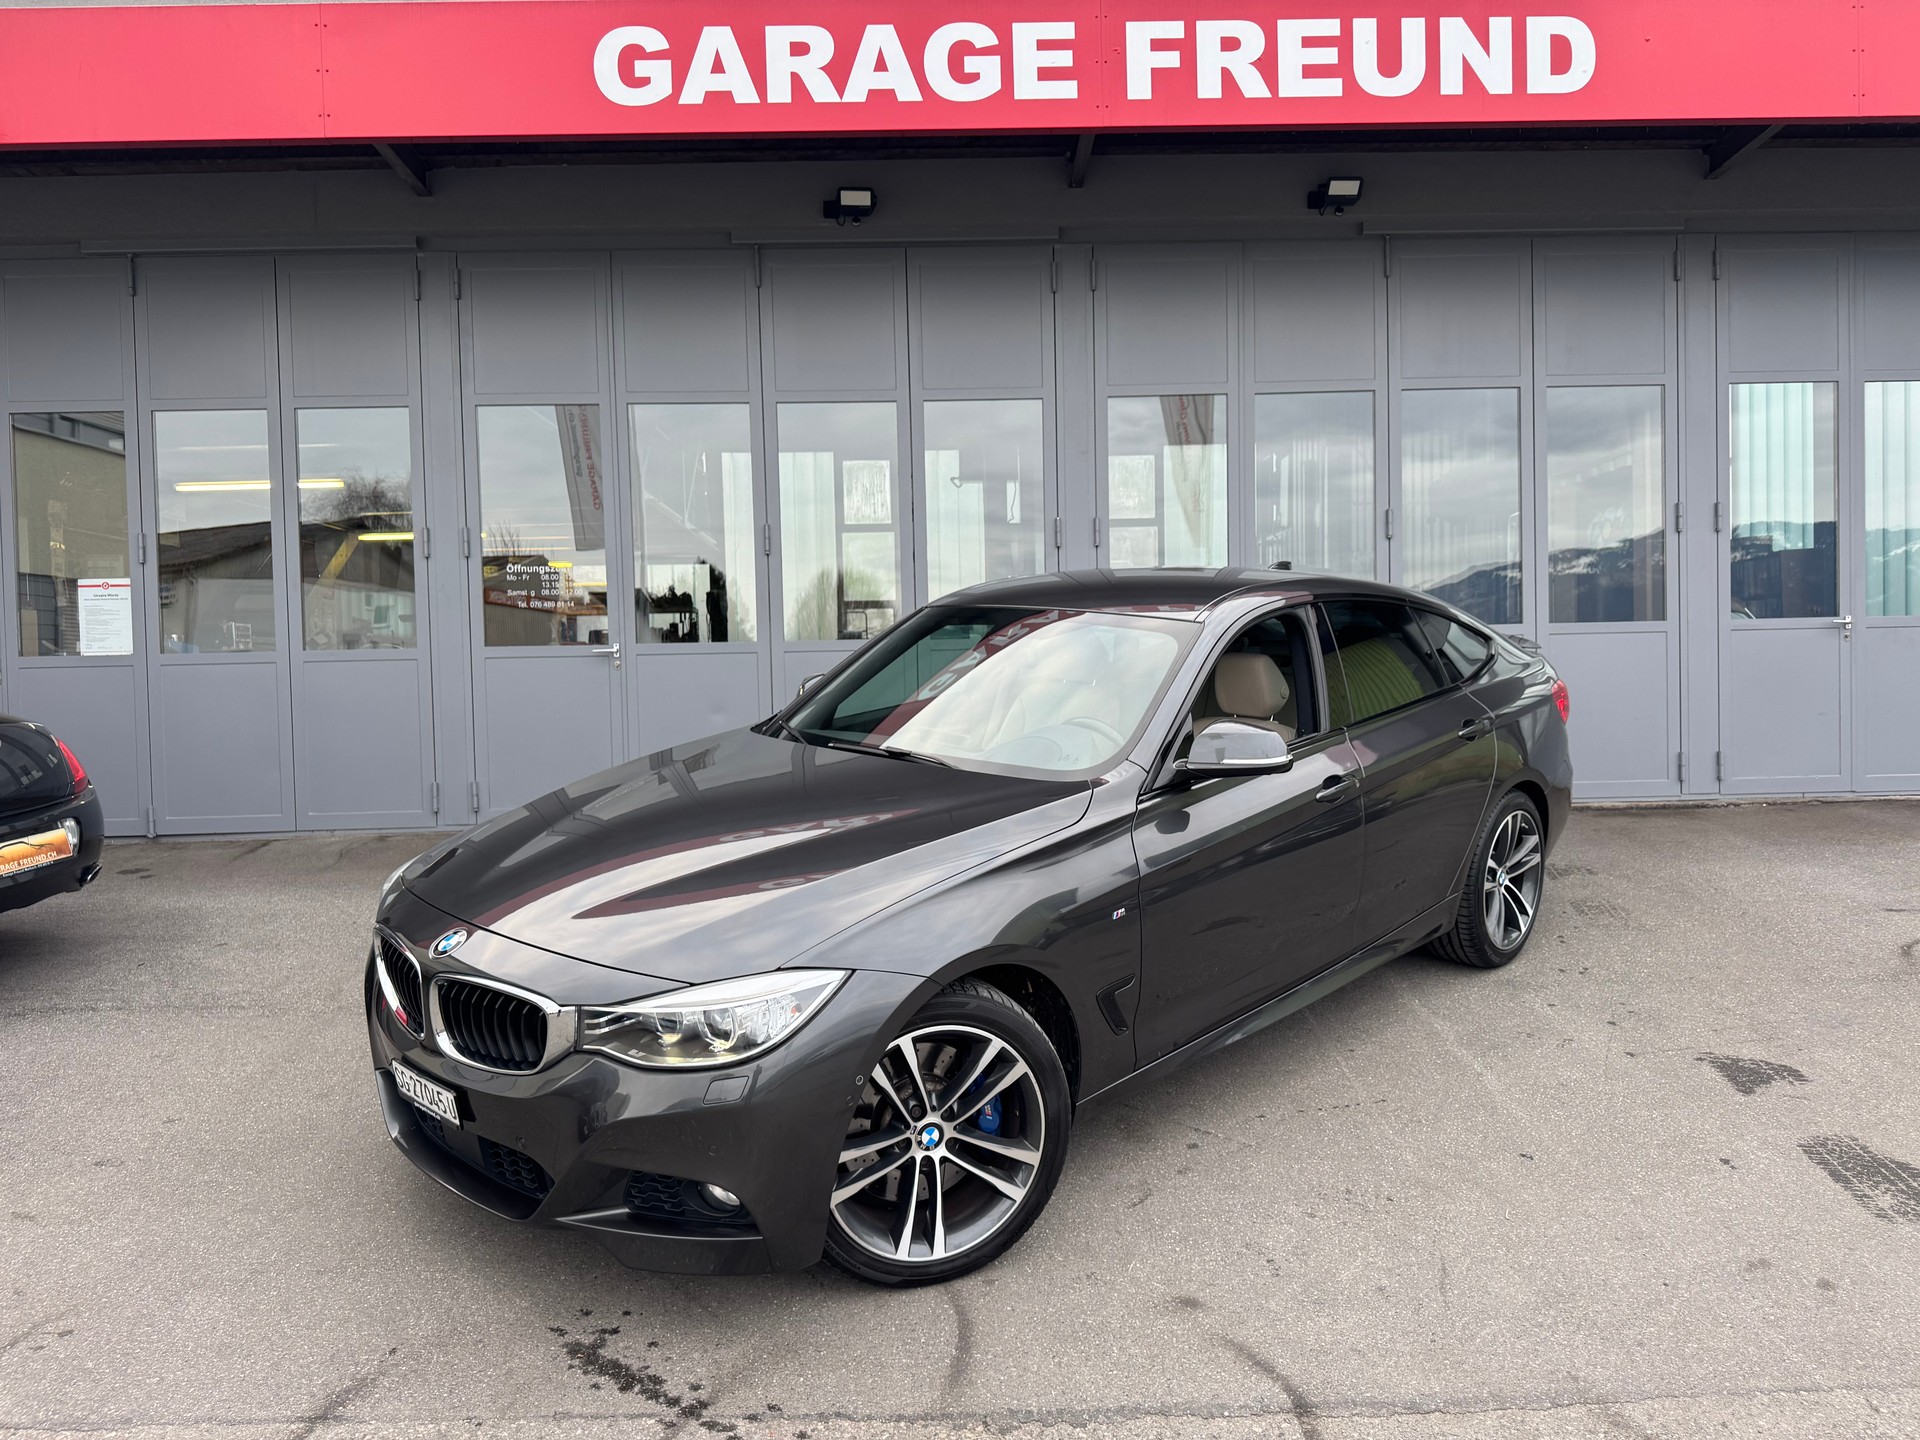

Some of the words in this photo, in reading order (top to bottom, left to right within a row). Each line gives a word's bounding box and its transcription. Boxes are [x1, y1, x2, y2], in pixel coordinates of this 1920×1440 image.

[593, 22, 1079, 106] GARAGE
[1125, 16, 1597, 100] FREUND
[507, 589, 536, 597] Samstg
[541, 588, 560, 596] 08.00
